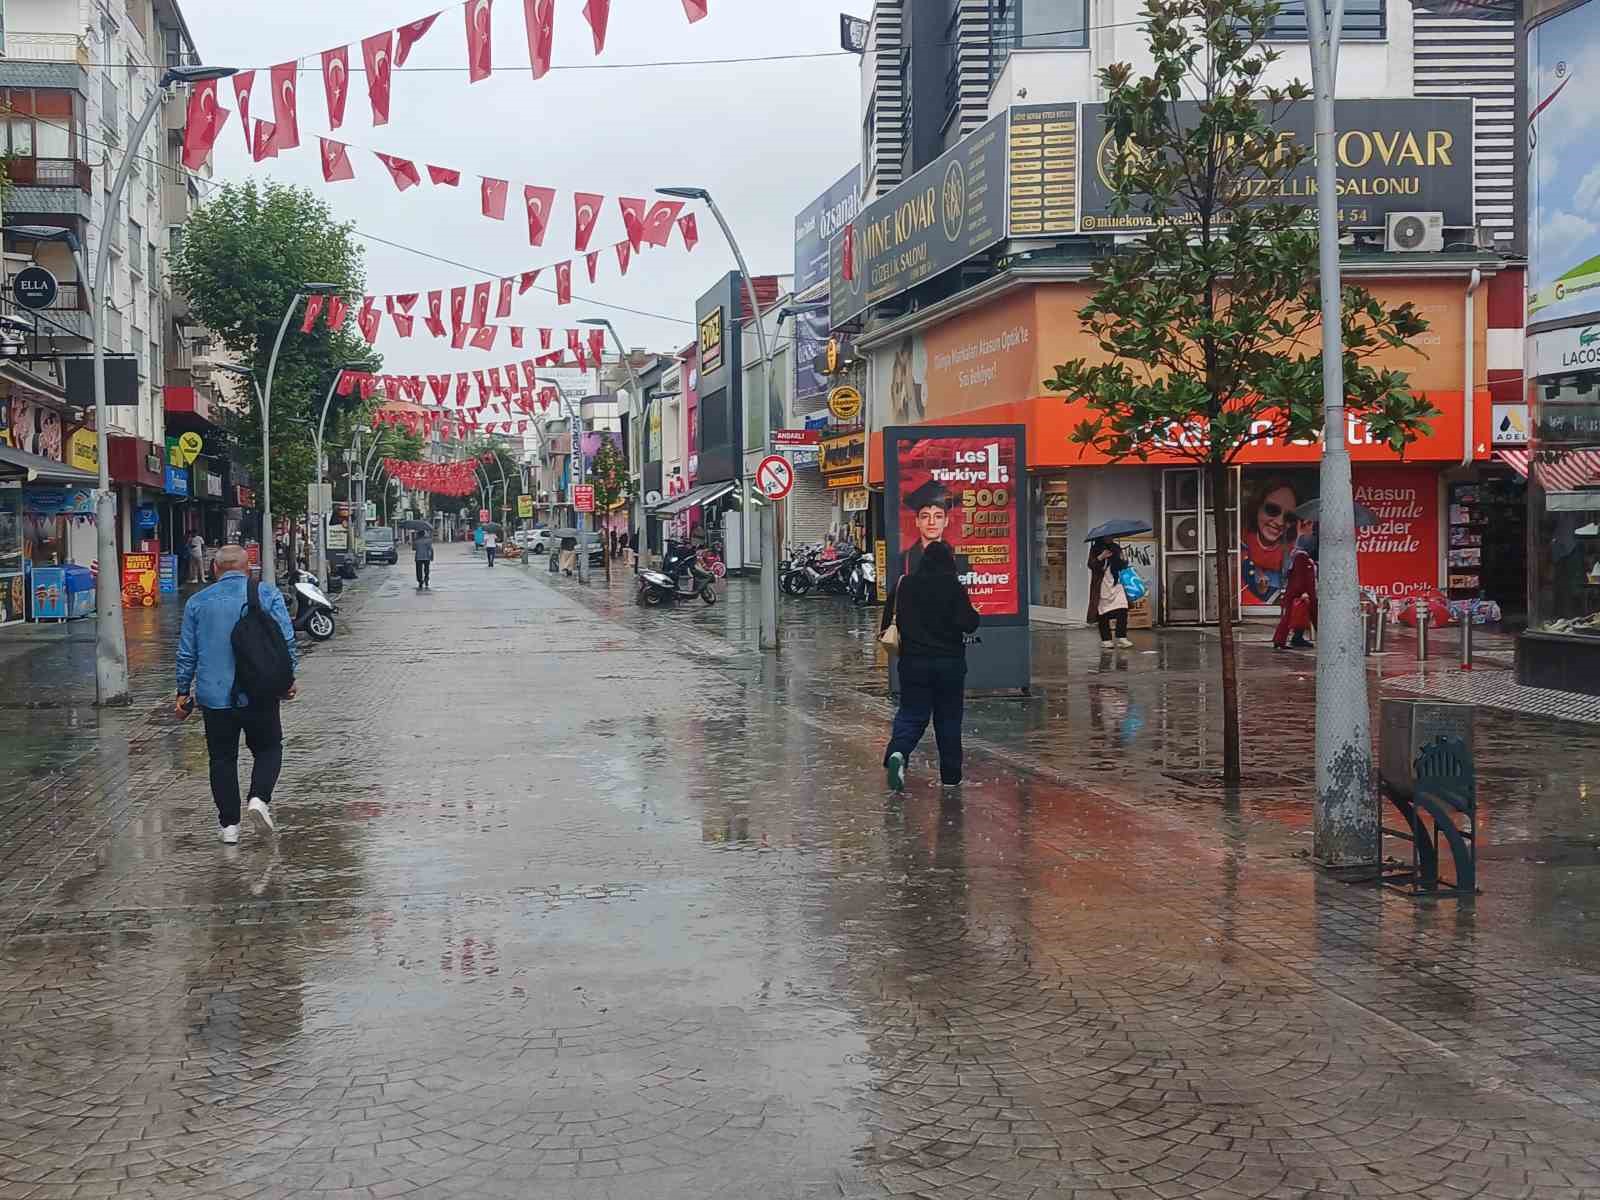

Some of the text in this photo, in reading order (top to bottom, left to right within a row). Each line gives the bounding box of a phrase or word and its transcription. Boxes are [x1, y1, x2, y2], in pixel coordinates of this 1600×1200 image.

[1335, 178, 1420, 196] SALONU
[894, 187, 936, 245] KOVAR
[1350, 208, 1368, 223] 54
[21, 280, 49, 290] ELLA
[1497, 433, 1528, 441] ADEL
[955, 450, 987, 464] LGS
[931, 467, 987, 486] Türkiye
[962, 489, 1009, 507] 500
[1354, 486, 1416, 500] Atasun
